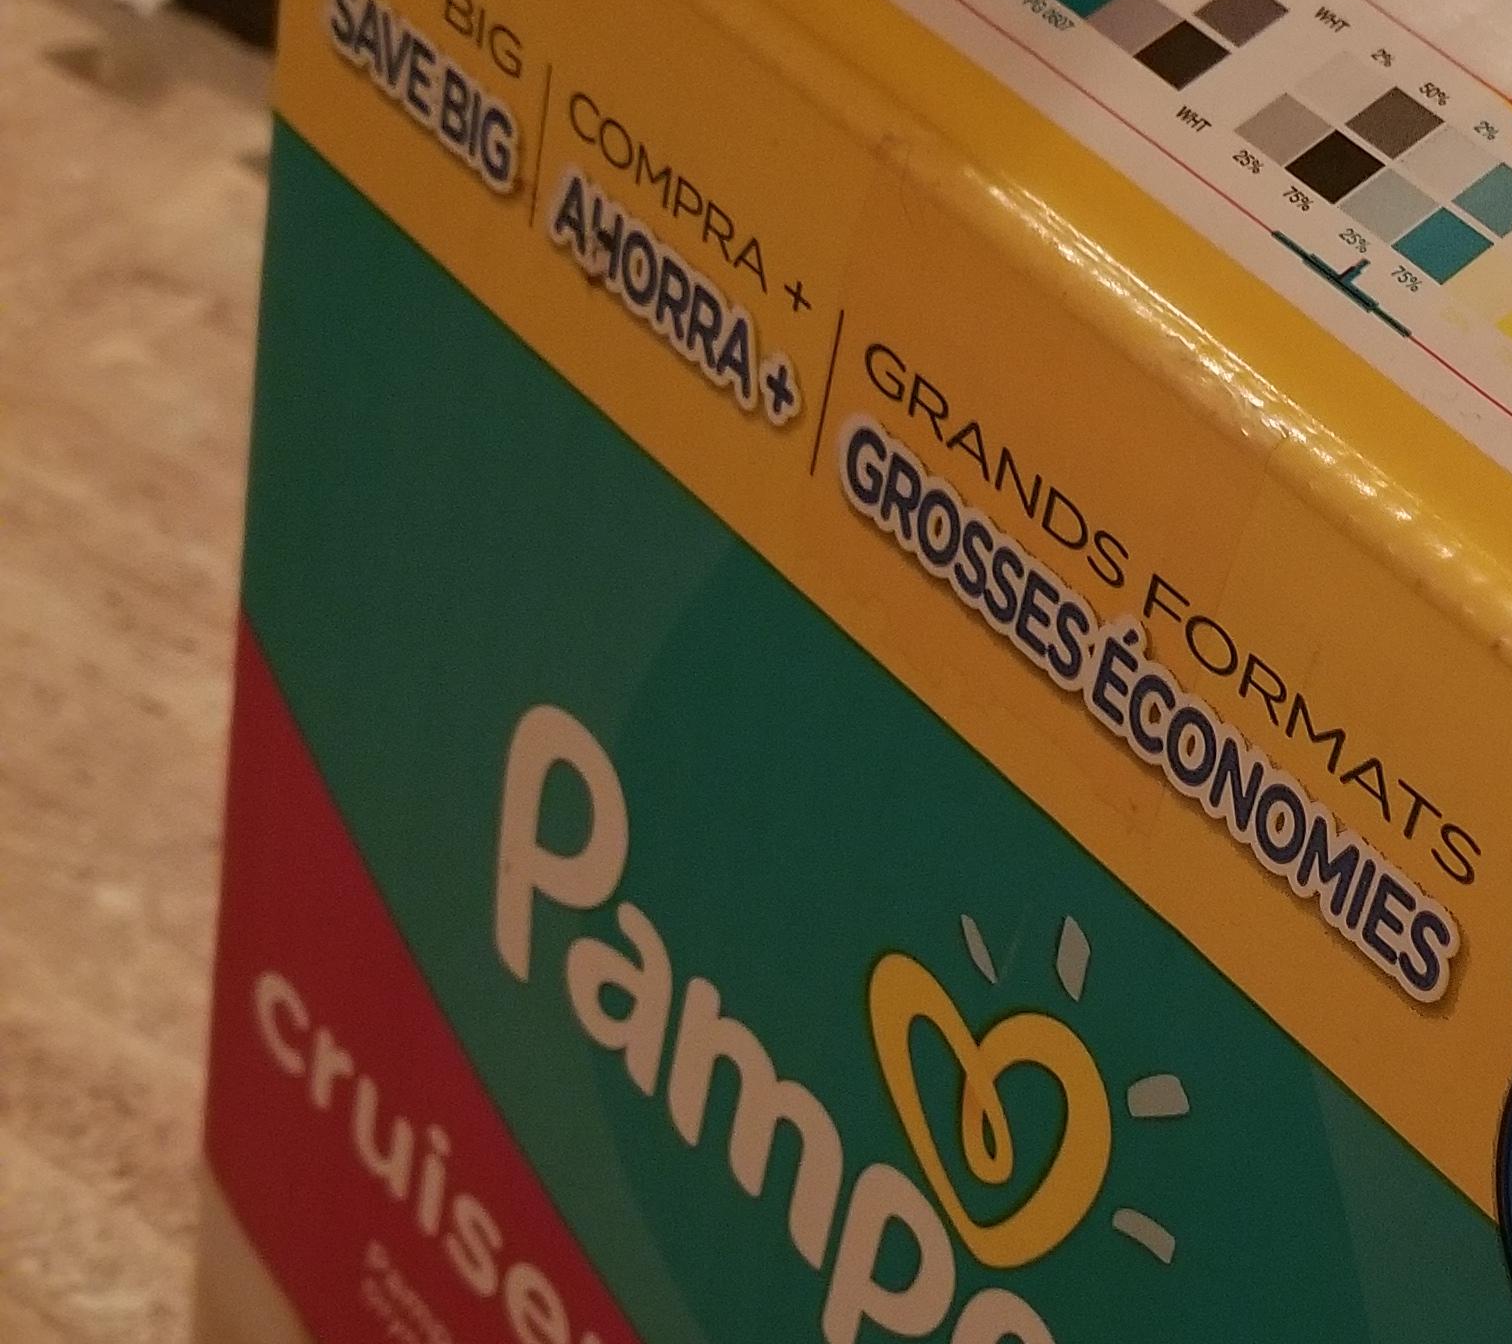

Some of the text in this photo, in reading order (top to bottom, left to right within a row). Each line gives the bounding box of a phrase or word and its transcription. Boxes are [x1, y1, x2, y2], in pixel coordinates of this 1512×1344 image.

[1314, 6, 1351, 33] WHT
[1370, 48, 1451, 107] 2% 50%
[440, 67, 515, 186] BIG
[1175, 105, 1212, 133] WHT
[1472, 120, 1499, 141] 2%
[568, 91, 812, 312] COMPRA +
[1231, 149, 1314, 212] 25% 75%
[1337, 227, 1423, 293] 25% 75%
[552, 174, 797, 416] AHORRA +
[863, 342, 1483, 886] GRANDS FORMATS
[845, 424, 1453, 994] GROSSES ÉCONOMIES
